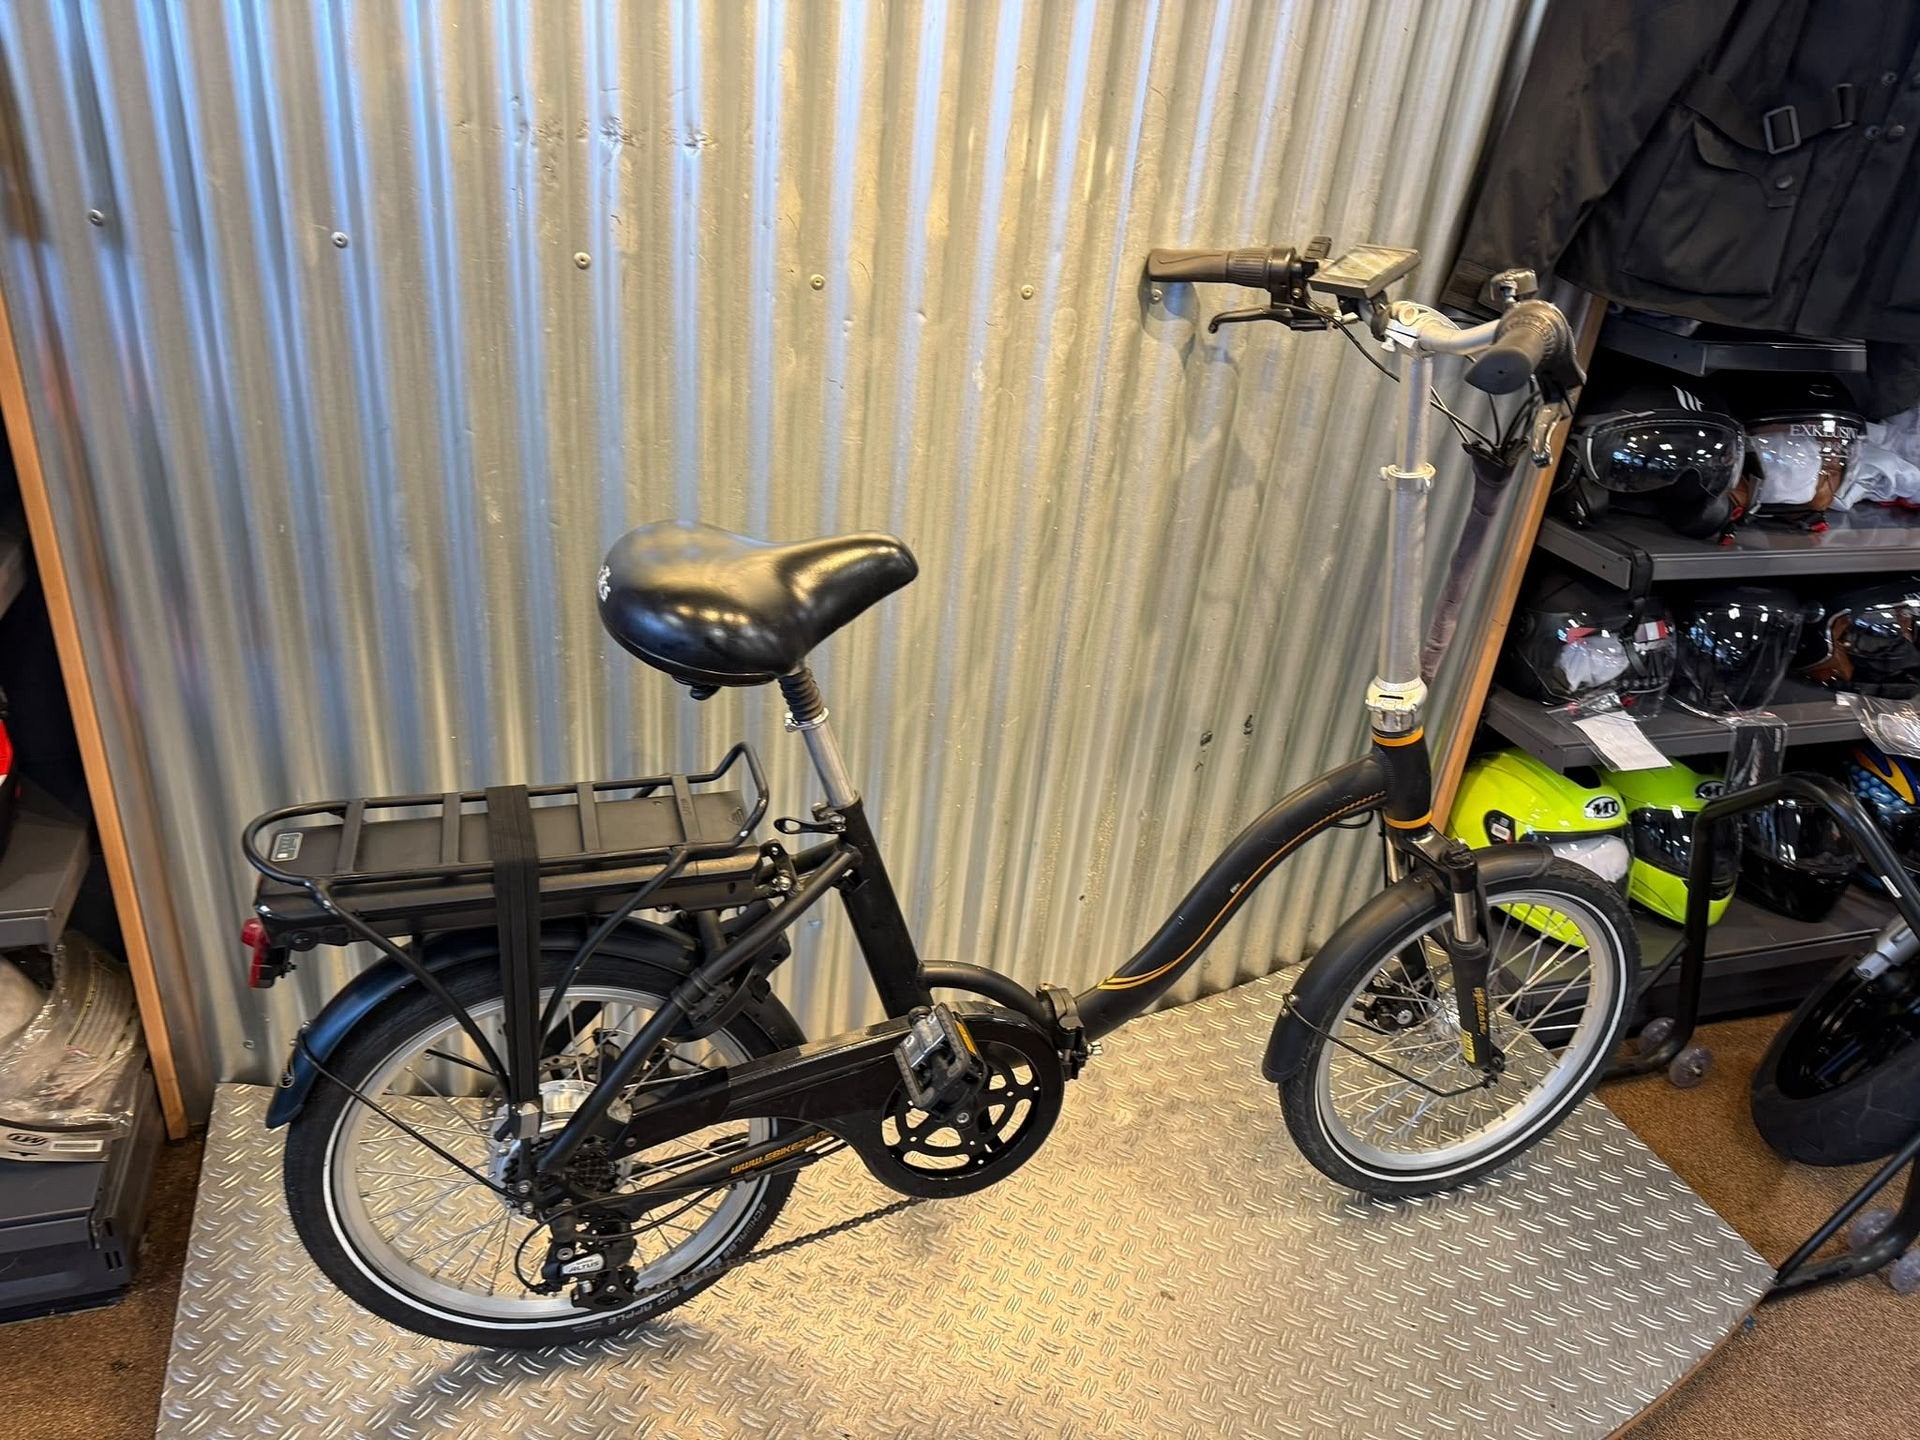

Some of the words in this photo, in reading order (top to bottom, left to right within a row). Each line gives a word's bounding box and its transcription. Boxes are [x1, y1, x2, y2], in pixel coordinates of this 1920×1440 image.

[1589, 798, 1619, 817] MT
[568, 1260, 600, 1273] ALTUS
[607, 1301, 654, 1325] APPLE
